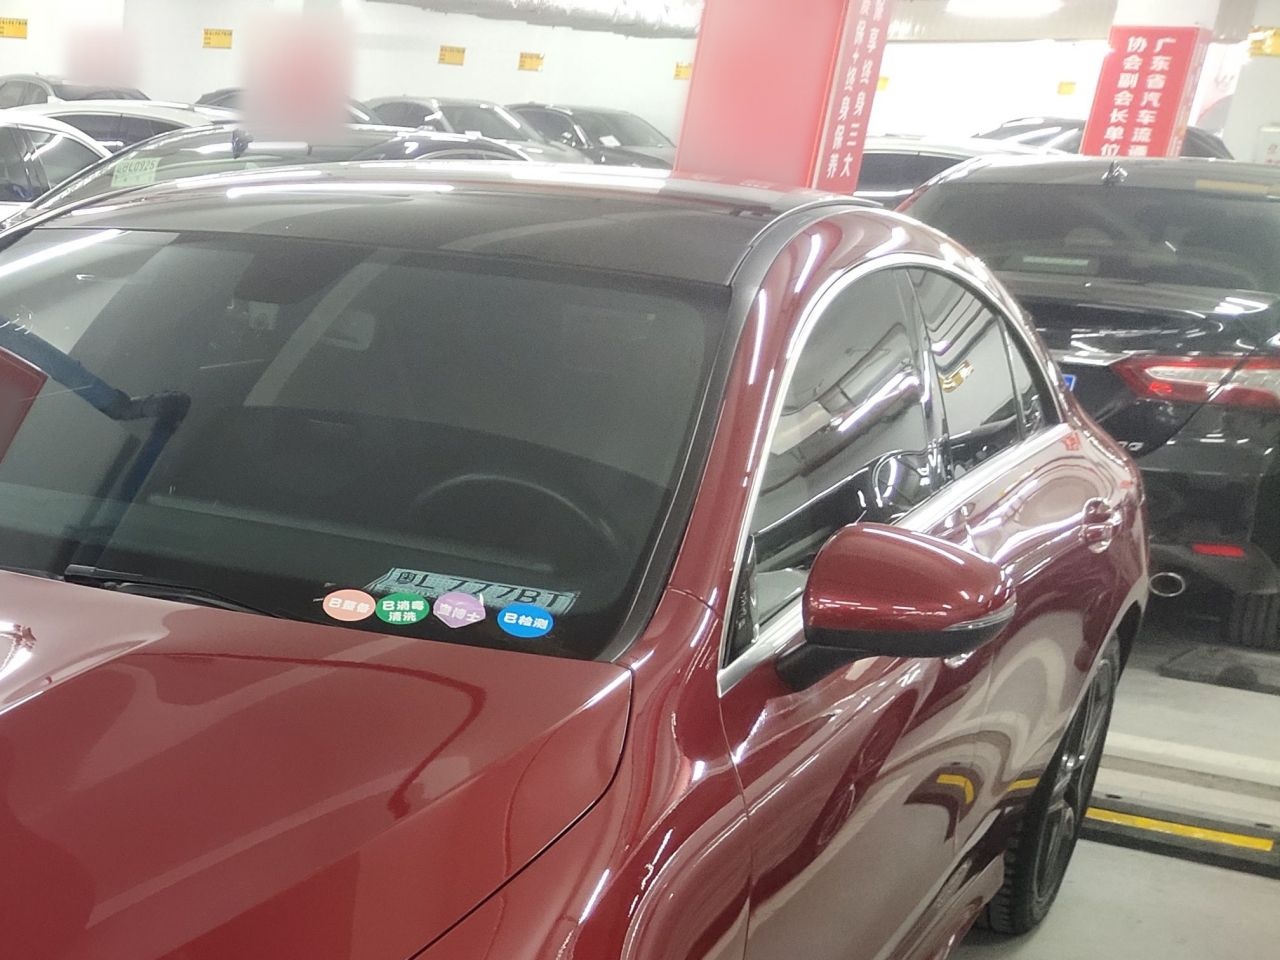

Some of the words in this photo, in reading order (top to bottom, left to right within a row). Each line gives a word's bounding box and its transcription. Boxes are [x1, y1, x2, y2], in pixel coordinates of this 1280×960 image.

[382, 600, 424, 611] 已消毒
[504, 612, 549, 630] 已检测
